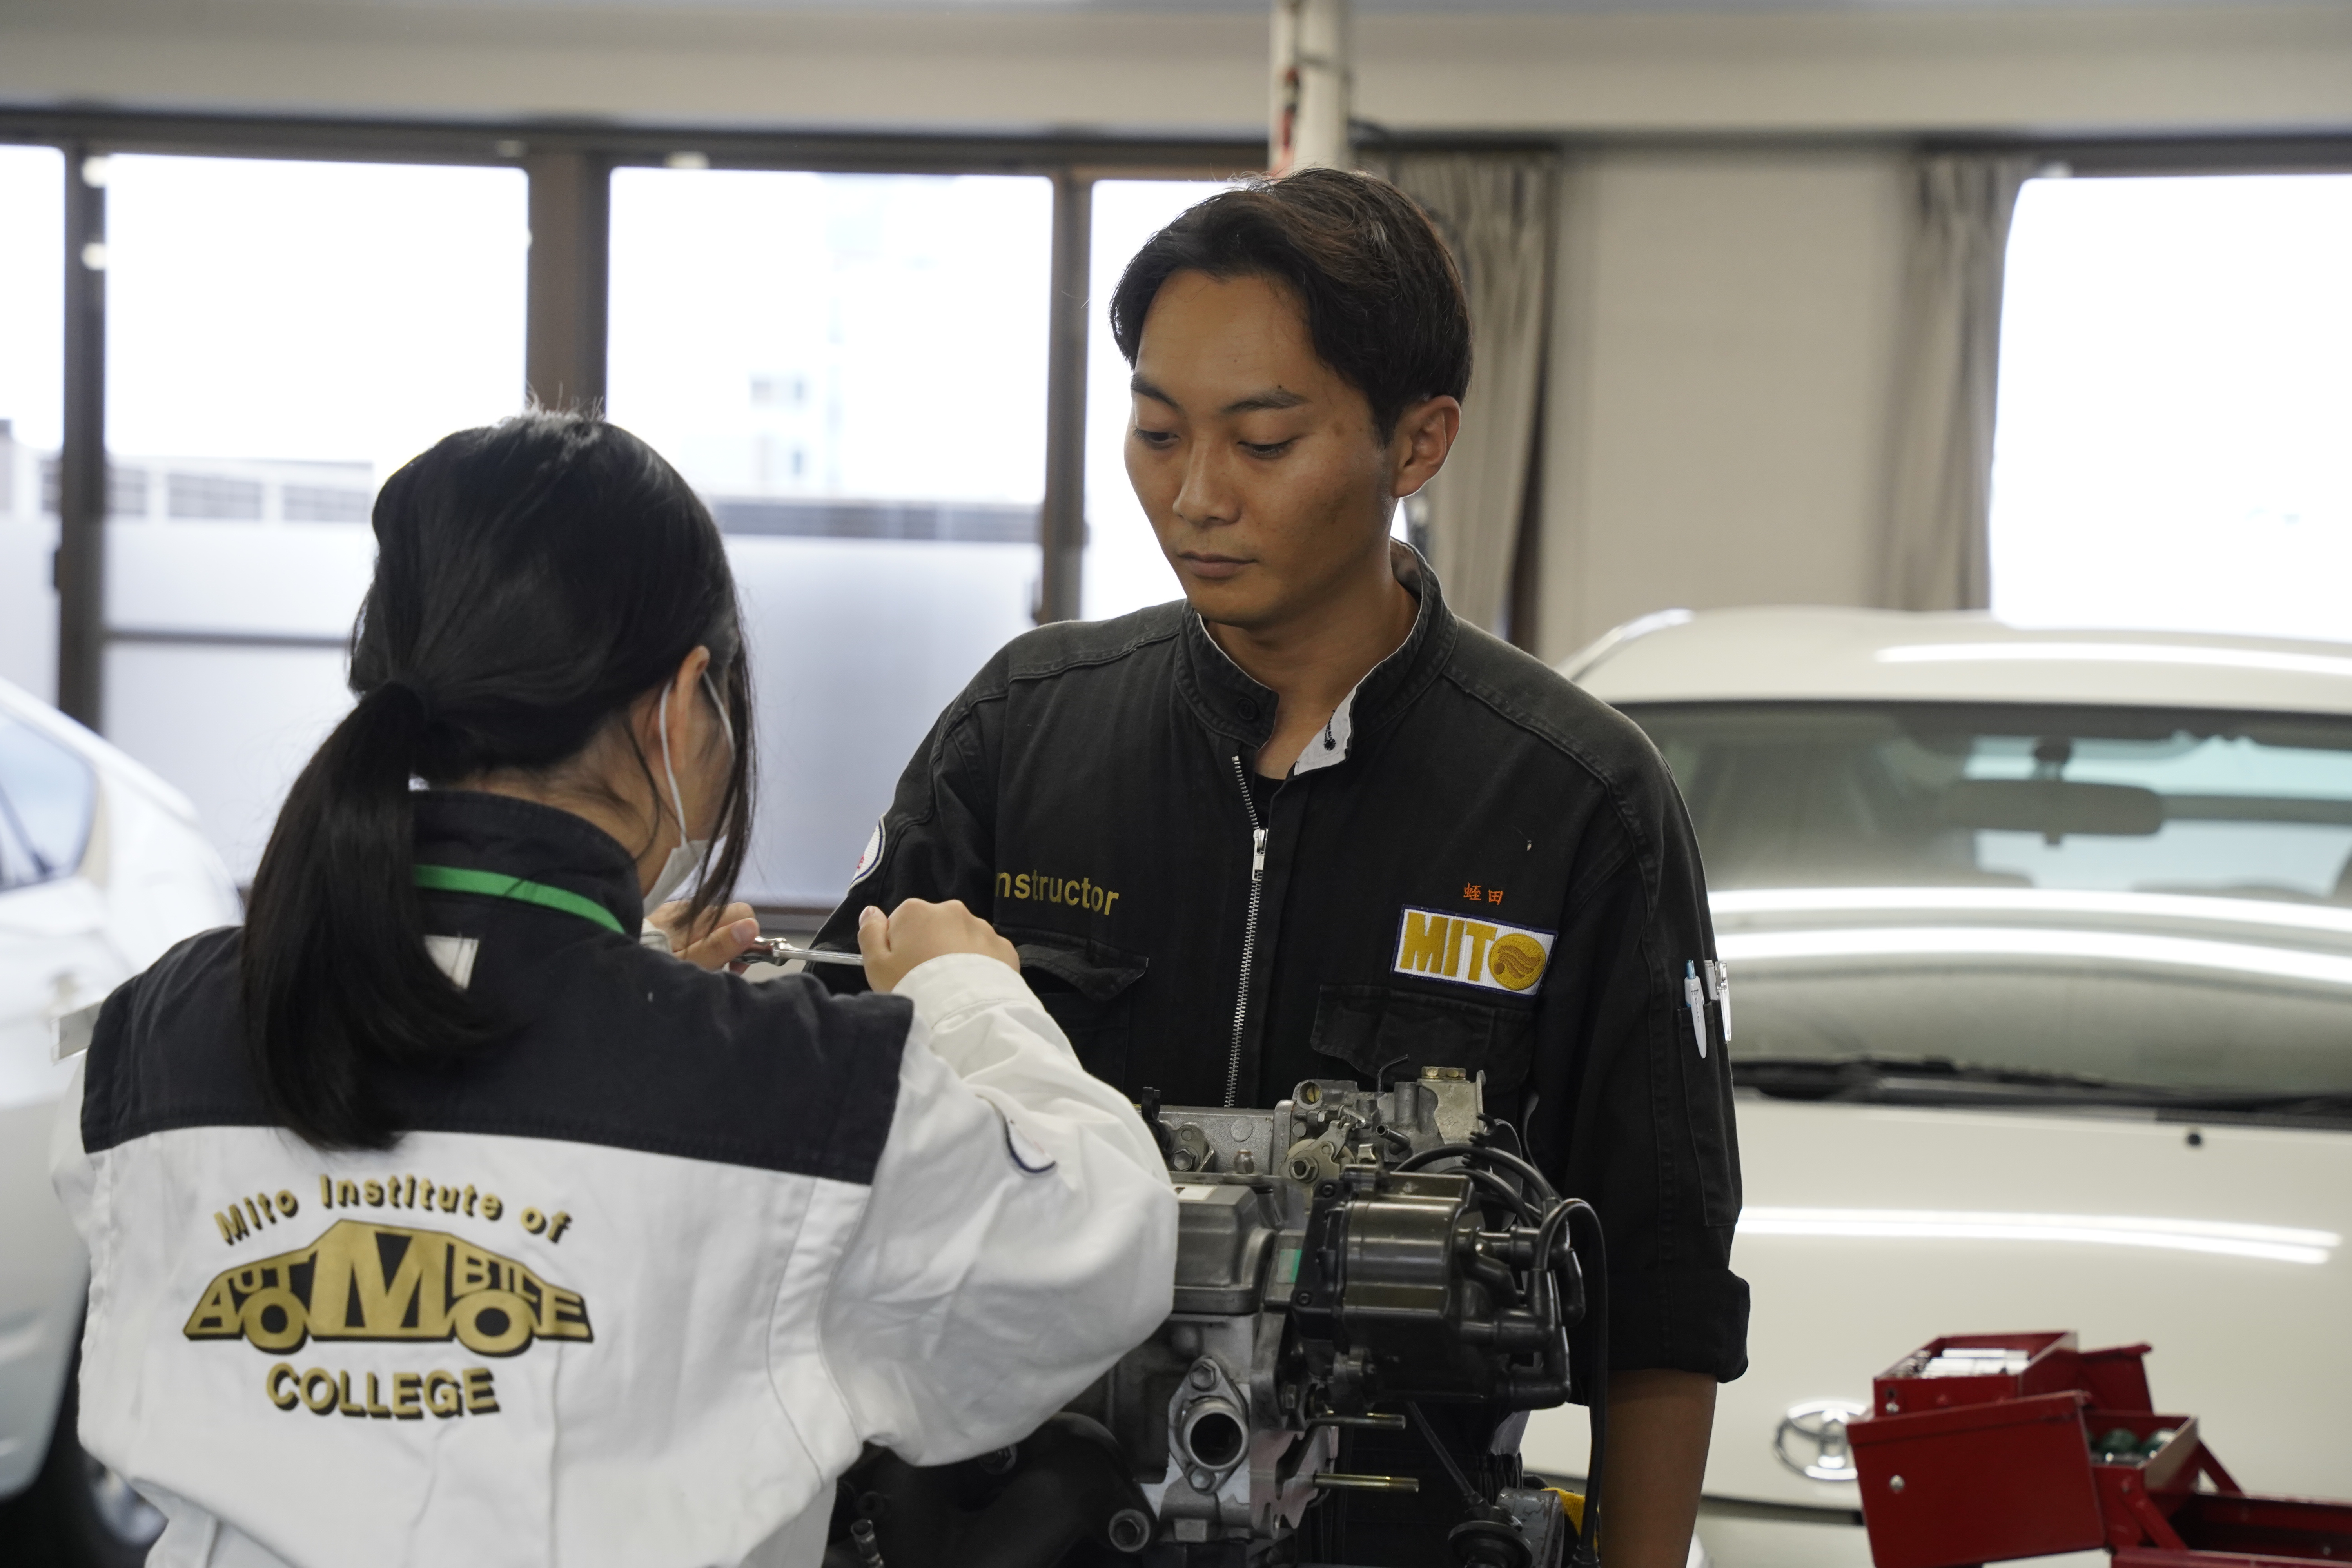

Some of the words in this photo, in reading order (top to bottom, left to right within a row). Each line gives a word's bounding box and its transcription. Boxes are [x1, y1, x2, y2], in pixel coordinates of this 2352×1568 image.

[995, 869, 1120, 916] nstructor
[214, 1188, 298, 1245] Mito
[319, 1173, 503, 1221] Institute
[520, 1206, 573, 1244] of
[266, 1362, 501, 1421] COLLEGE
